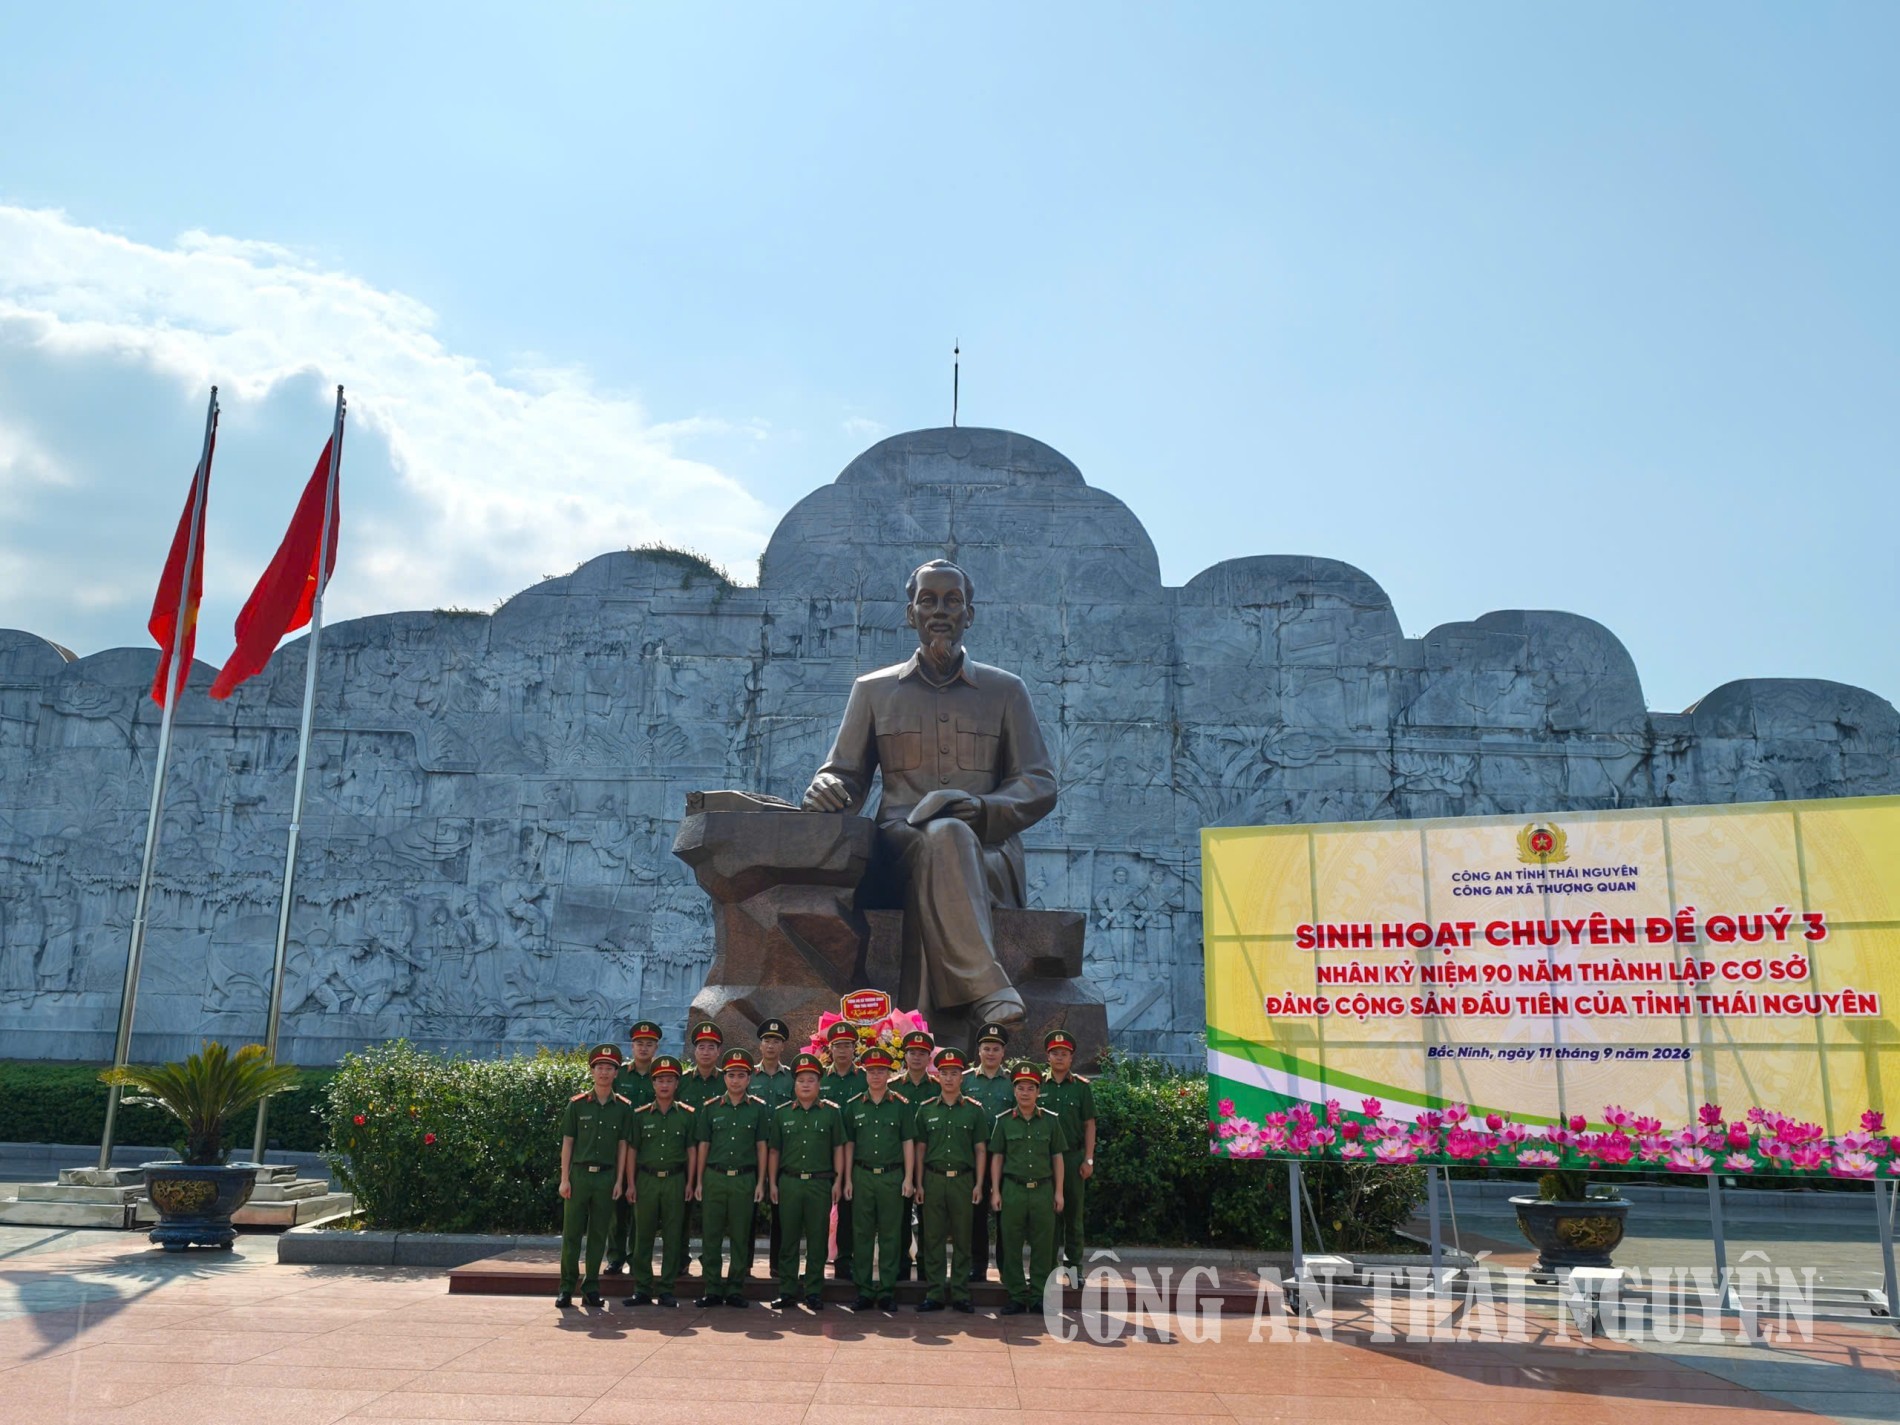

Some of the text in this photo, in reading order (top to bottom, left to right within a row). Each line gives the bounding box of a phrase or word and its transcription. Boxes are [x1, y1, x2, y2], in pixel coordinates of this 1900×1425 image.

[1451, 864, 1638, 882] CÔNG AN TỈNH THÁI NGUYÊN
[1453, 881, 1636, 896] CÔNG AN XÃ THƯỢNG QUAN
[1296, 905, 1826, 956] SINH HOẠT CHUYÊN ĐỀ QUÝ 3
[1317, 953, 1808, 989] NHÂN KỶ NIỆM 90 NĂM THÀNH LẬP CƠ SỞ
[1266, 988, 1878, 1020] ĐẢNG CỘNG SẢN ĐẦU TIÊN CỦA TỈNH THÁI NGUYÊN
[1427, 1045, 1692, 1062] Bắc Ninh, ngày 11 tháng 9 năm 2026
